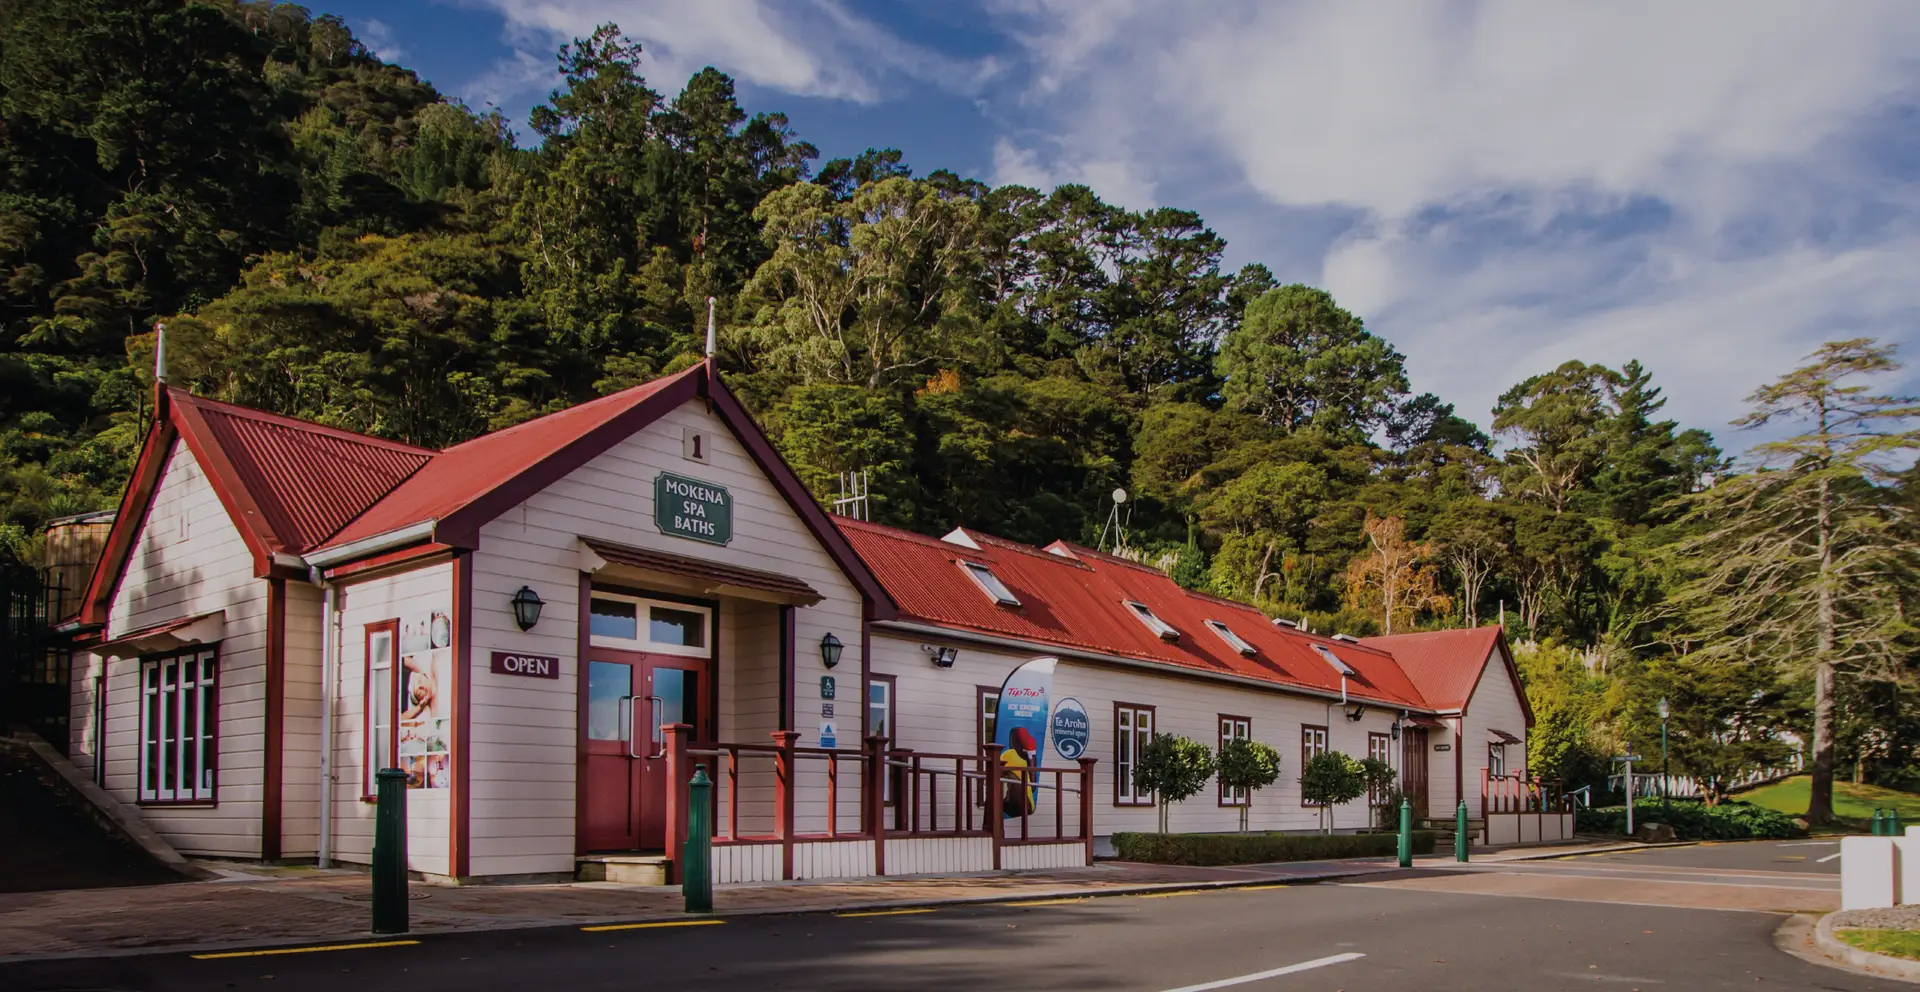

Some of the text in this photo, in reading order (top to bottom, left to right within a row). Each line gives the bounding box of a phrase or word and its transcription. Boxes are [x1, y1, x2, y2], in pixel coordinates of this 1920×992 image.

[692, 434, 702, 459] 1
[666, 479, 724, 505] MOKENA
[683, 500, 706, 518] SPA
[674, 515, 715, 536] BATHS
[503, 655, 549, 675] OPEN
[1008, 687, 1040, 698] Tip Top
[1055, 716, 1086, 729] Te Aroha
